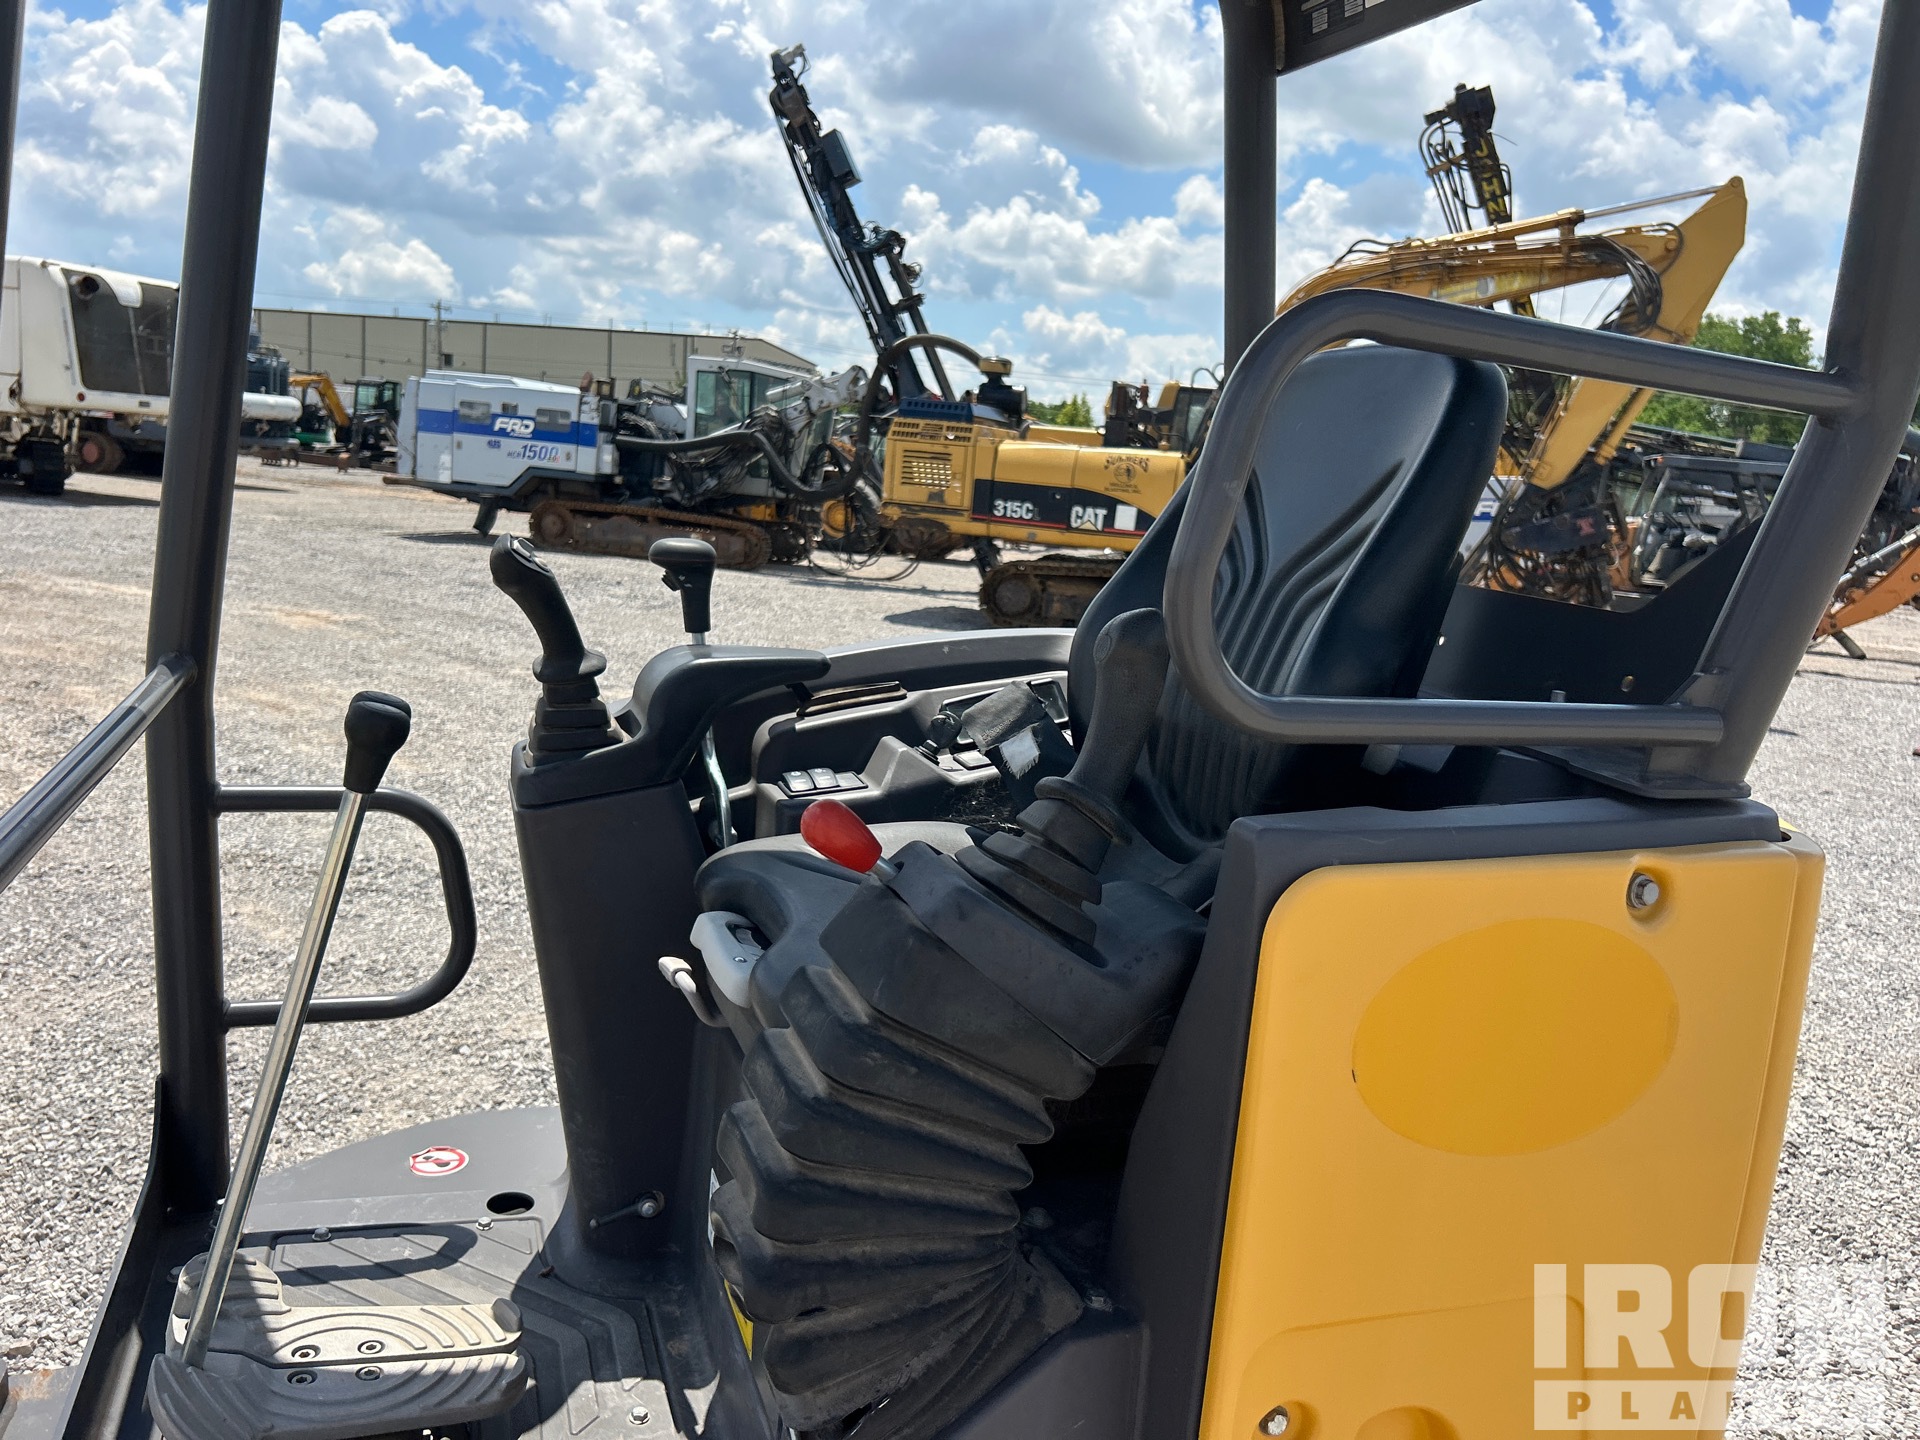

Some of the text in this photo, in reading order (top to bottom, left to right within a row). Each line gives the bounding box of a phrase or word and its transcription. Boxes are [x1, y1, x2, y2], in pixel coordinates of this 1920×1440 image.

[494, 417, 535, 434] FRD
[521, 443, 560, 462] 1500
[993, 499, 1033, 519] 315C
[1070, 505, 1108, 531] CAT
